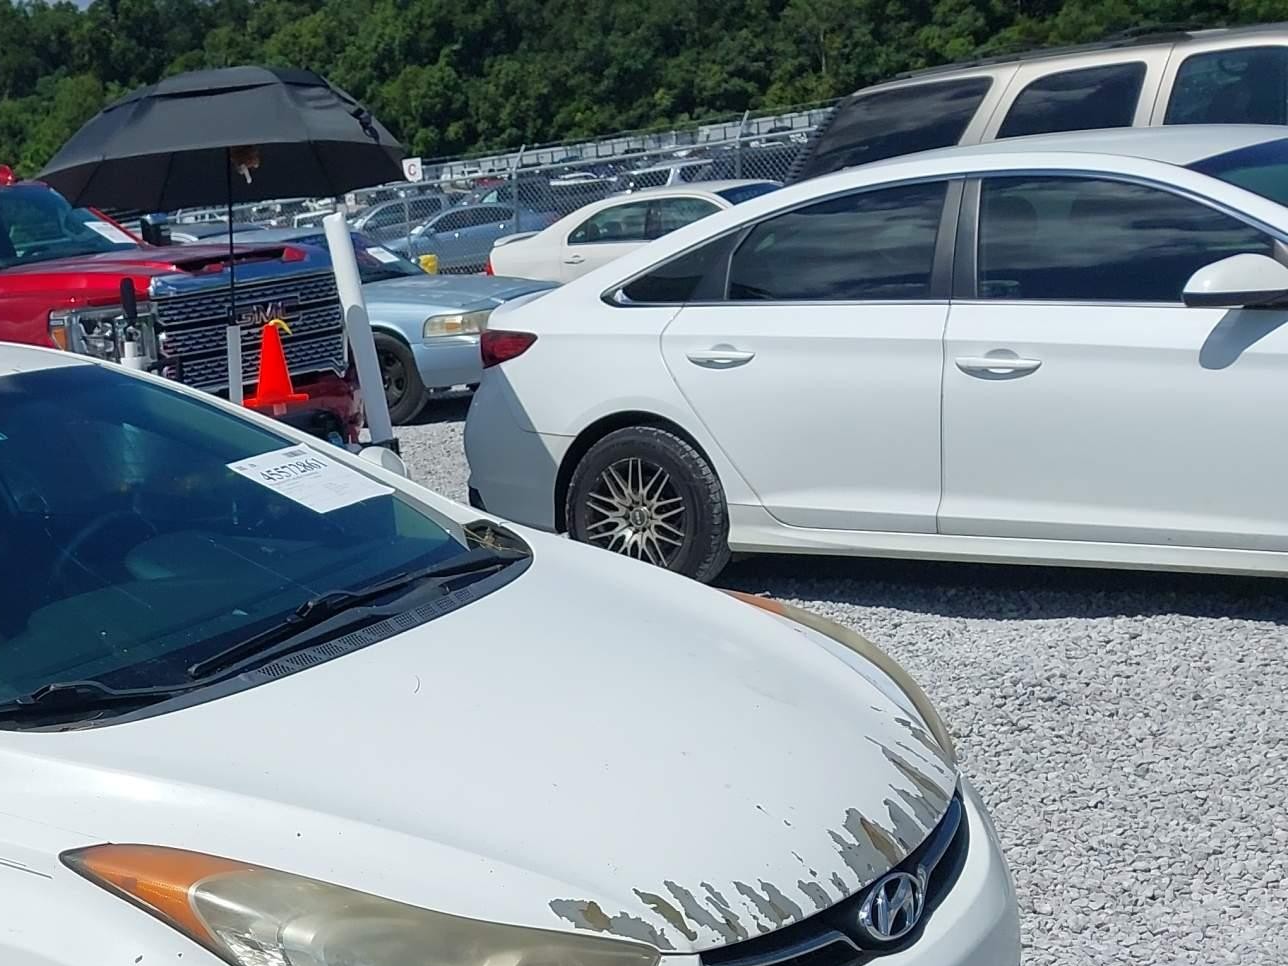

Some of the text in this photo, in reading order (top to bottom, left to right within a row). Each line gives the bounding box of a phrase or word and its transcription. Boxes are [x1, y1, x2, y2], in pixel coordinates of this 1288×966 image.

[408, 163, 417, 176] C
[233, 300, 299, 325] GMC
[260, 458, 328, 482] 45572861
